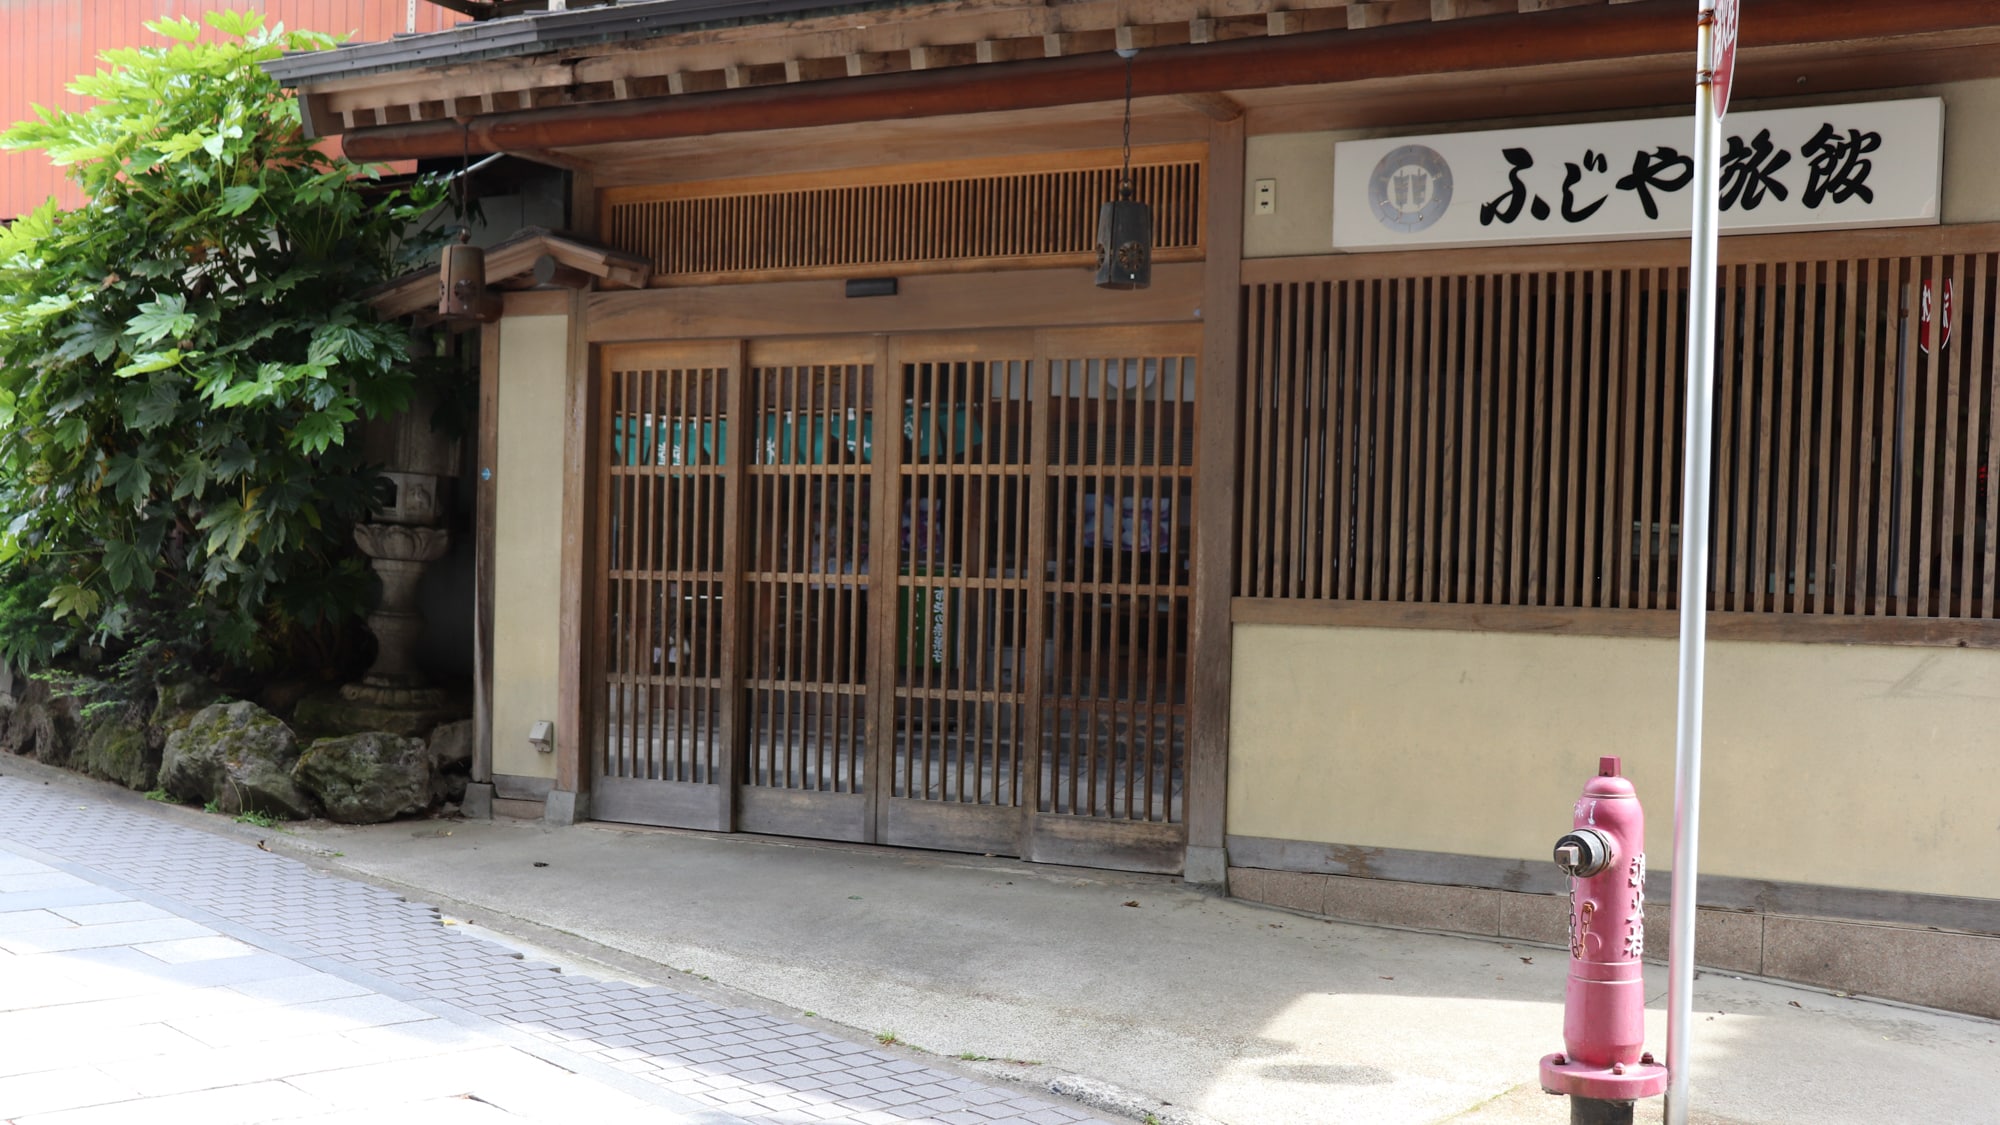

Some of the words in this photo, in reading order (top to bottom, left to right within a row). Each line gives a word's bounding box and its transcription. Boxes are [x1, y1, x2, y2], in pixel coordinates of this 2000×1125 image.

[1480, 122, 1882, 226] ふじや旅館
